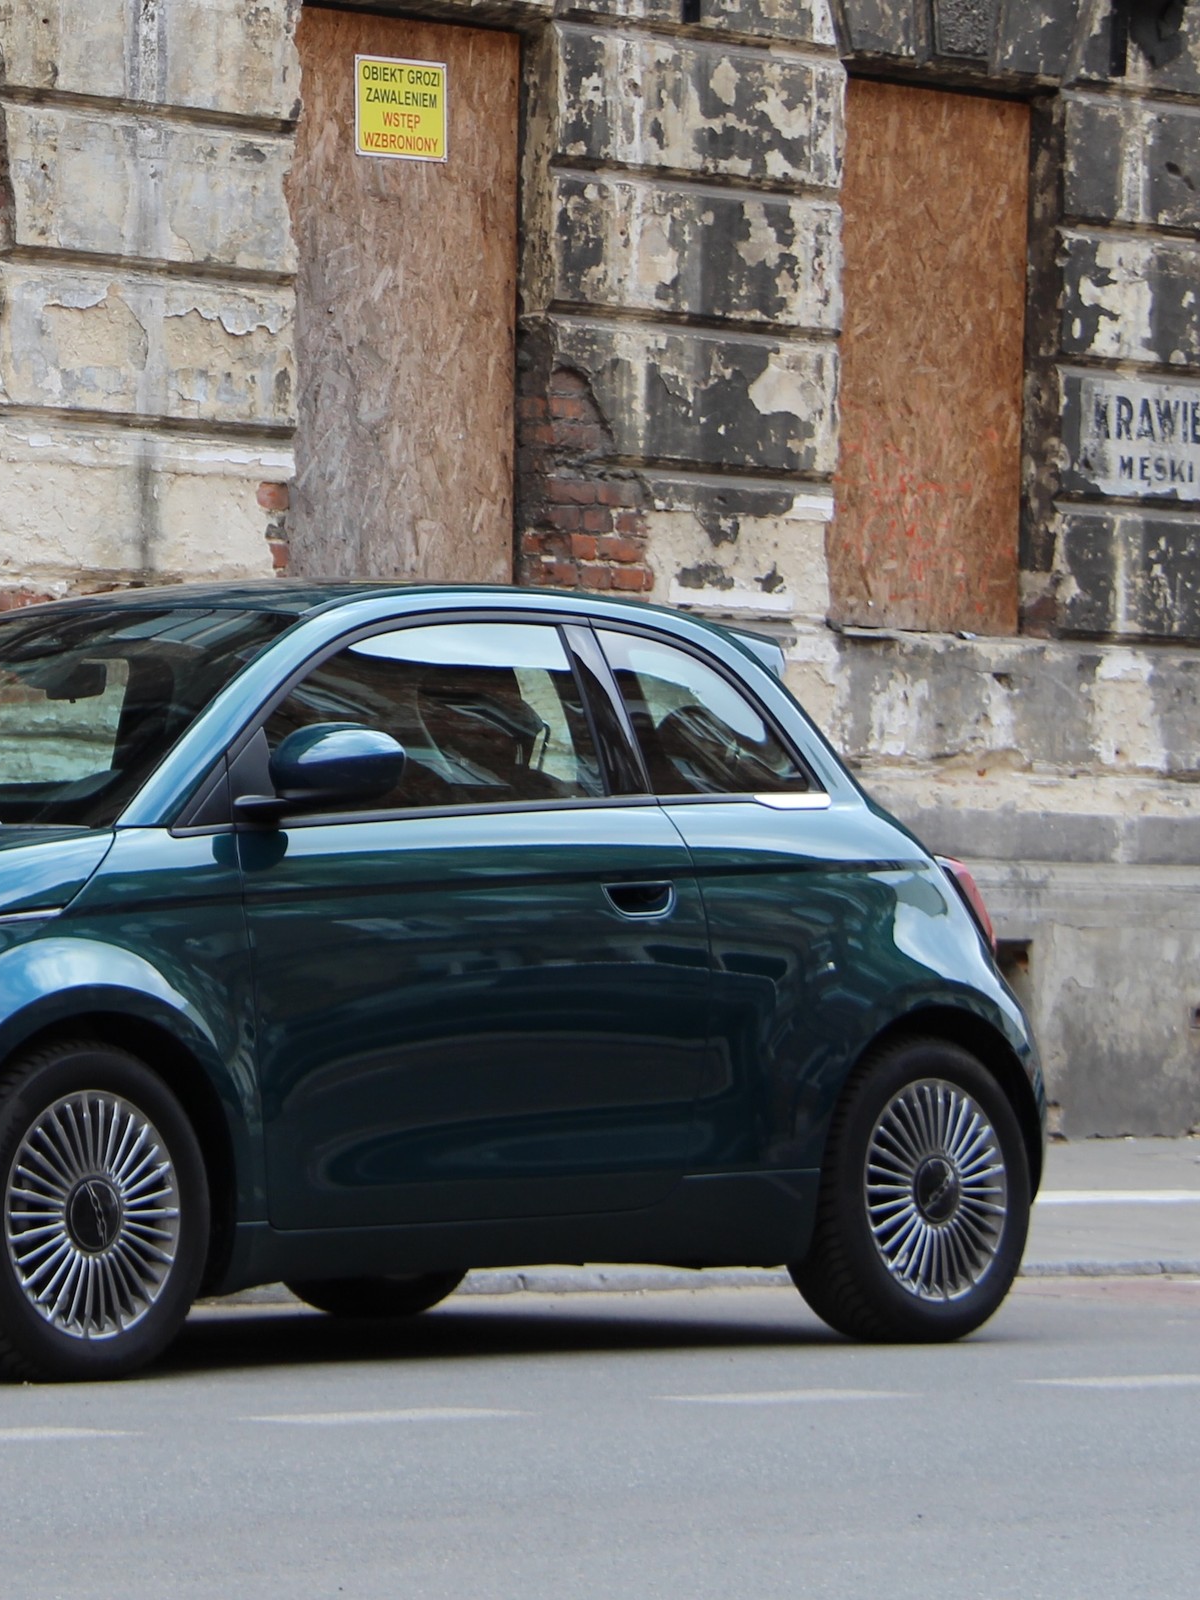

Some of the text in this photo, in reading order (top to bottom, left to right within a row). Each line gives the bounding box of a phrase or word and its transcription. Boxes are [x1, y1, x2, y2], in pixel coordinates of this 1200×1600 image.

[362, 65, 440, 87] OBIEKT GROZI
[365, 87, 437, 108] ZAWALENIEM
[382, 111, 421, 132] WSTĘP
[364, 132, 438, 152] WZBRONIONY
[1119, 455, 1194, 487] MĘSKI
